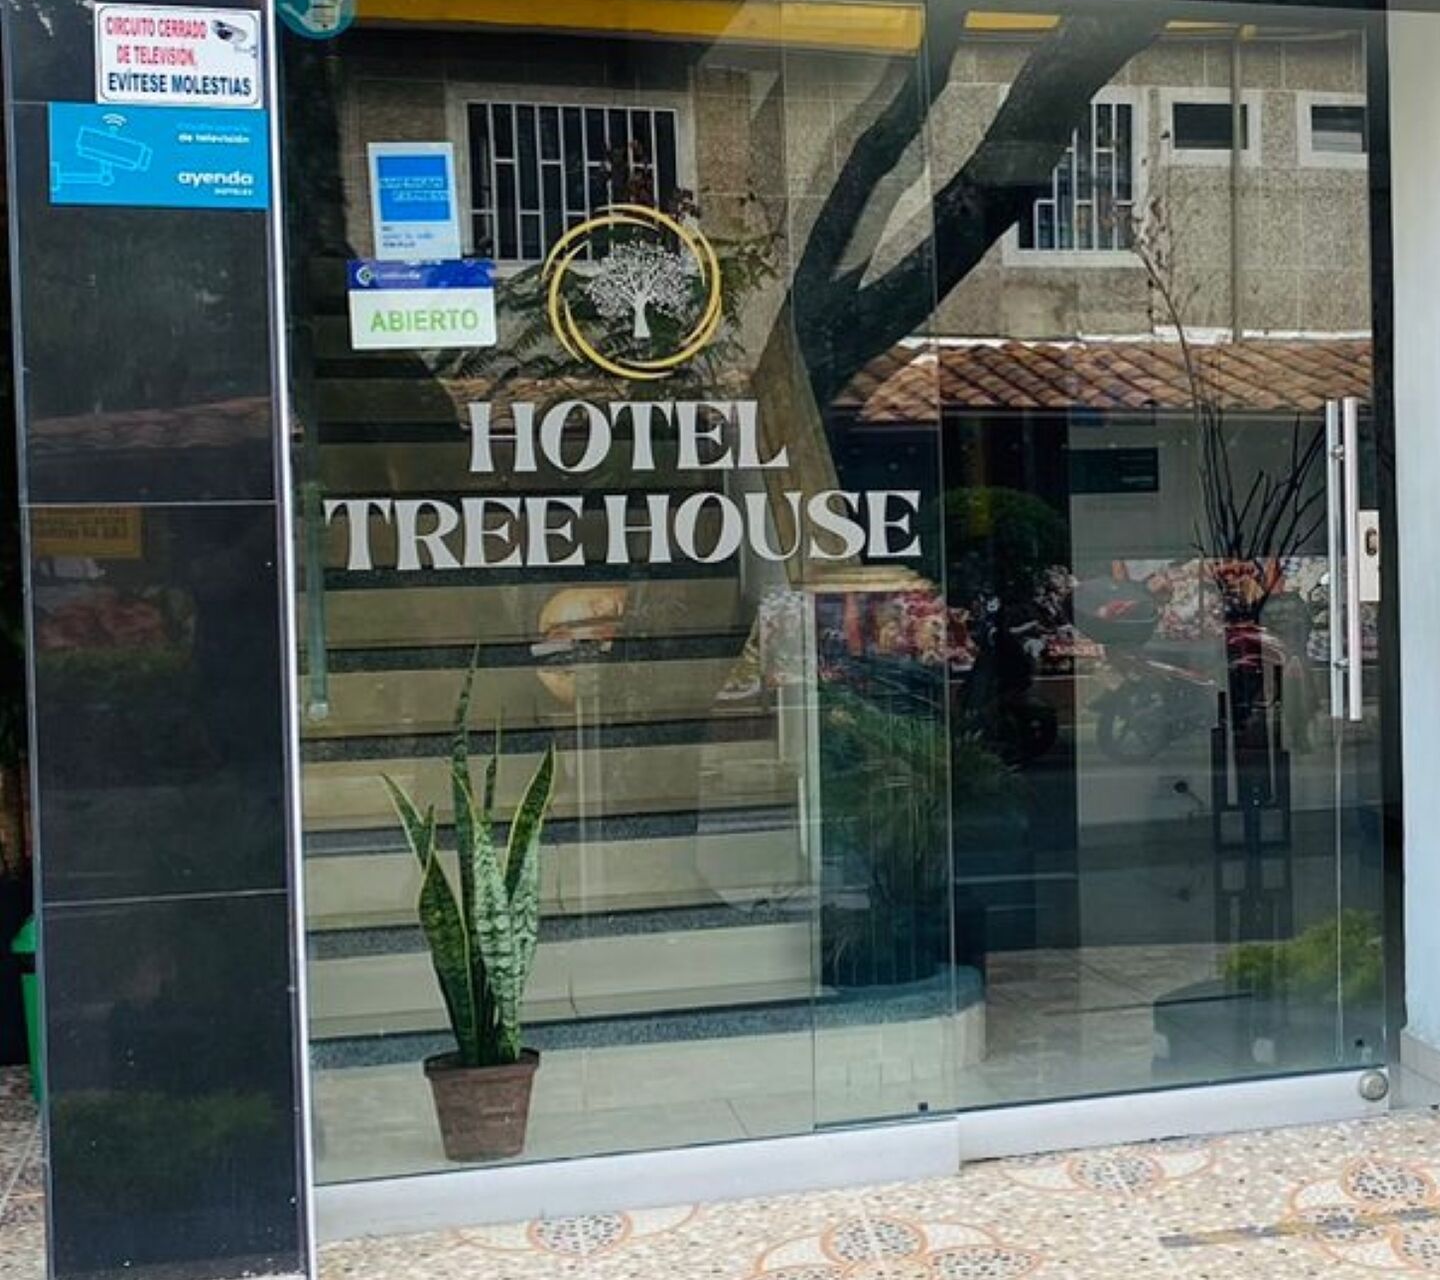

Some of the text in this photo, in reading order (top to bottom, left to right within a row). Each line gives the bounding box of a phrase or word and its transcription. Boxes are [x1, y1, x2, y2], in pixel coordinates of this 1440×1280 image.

[106, 16, 208, 40] CIRCUITO CERRADO
[116, 44, 131, 64] DE
[171, 75, 251, 97] MOLESTIAS
[178, 170, 254, 188] ayenda
[370, 310, 479, 332] ABIERTO
[467, 400, 789, 474] HOTEL
